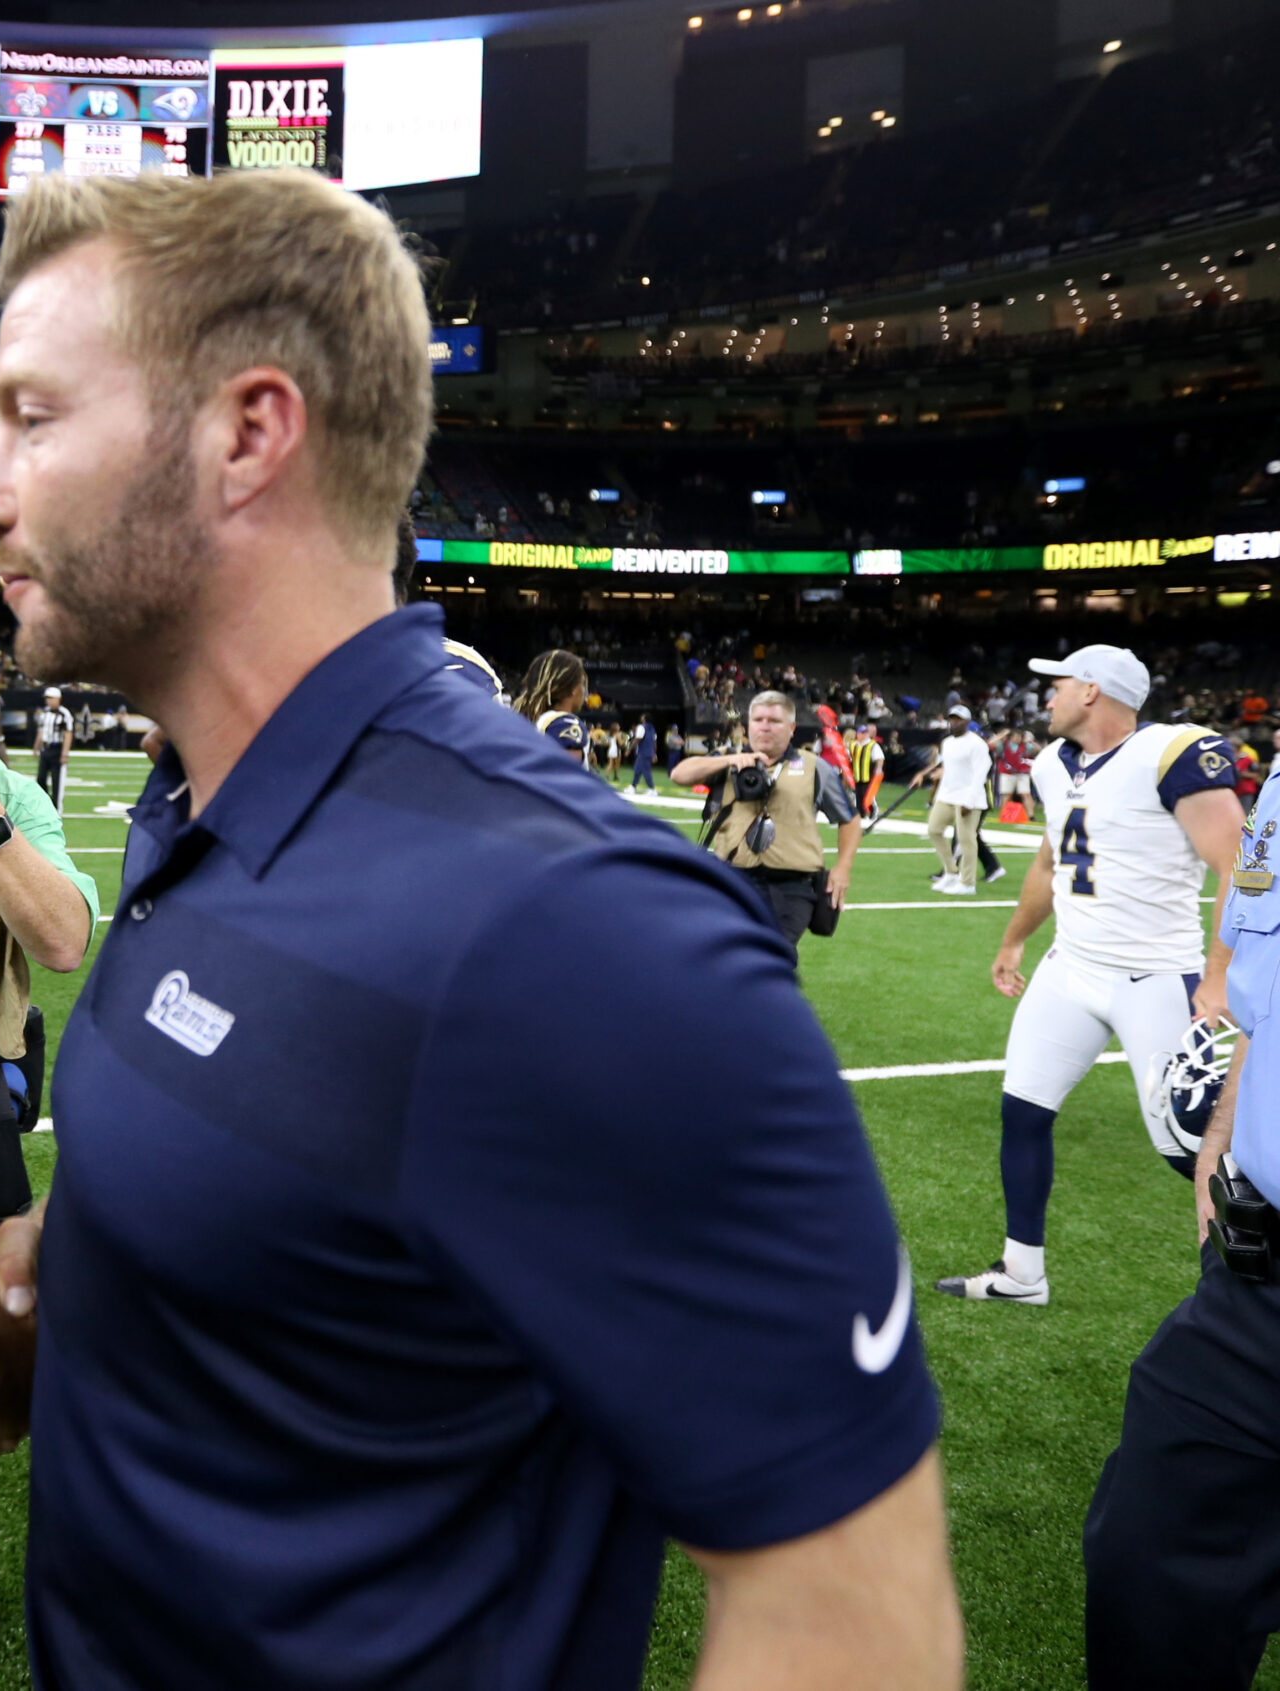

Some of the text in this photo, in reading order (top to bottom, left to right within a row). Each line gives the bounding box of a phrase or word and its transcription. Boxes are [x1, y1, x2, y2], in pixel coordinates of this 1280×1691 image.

[86, 90, 119, 116] VS
[227, 79, 329, 118] DIXIE
[227, 140, 316, 168] VOODOO
[489, 541, 729, 575] ORIGINAL AND REINVENTED
[1043, 538, 1167, 571] ORIGINAL
[1175, 535, 1214, 557] AND
[1060, 804, 1097, 897] 4
